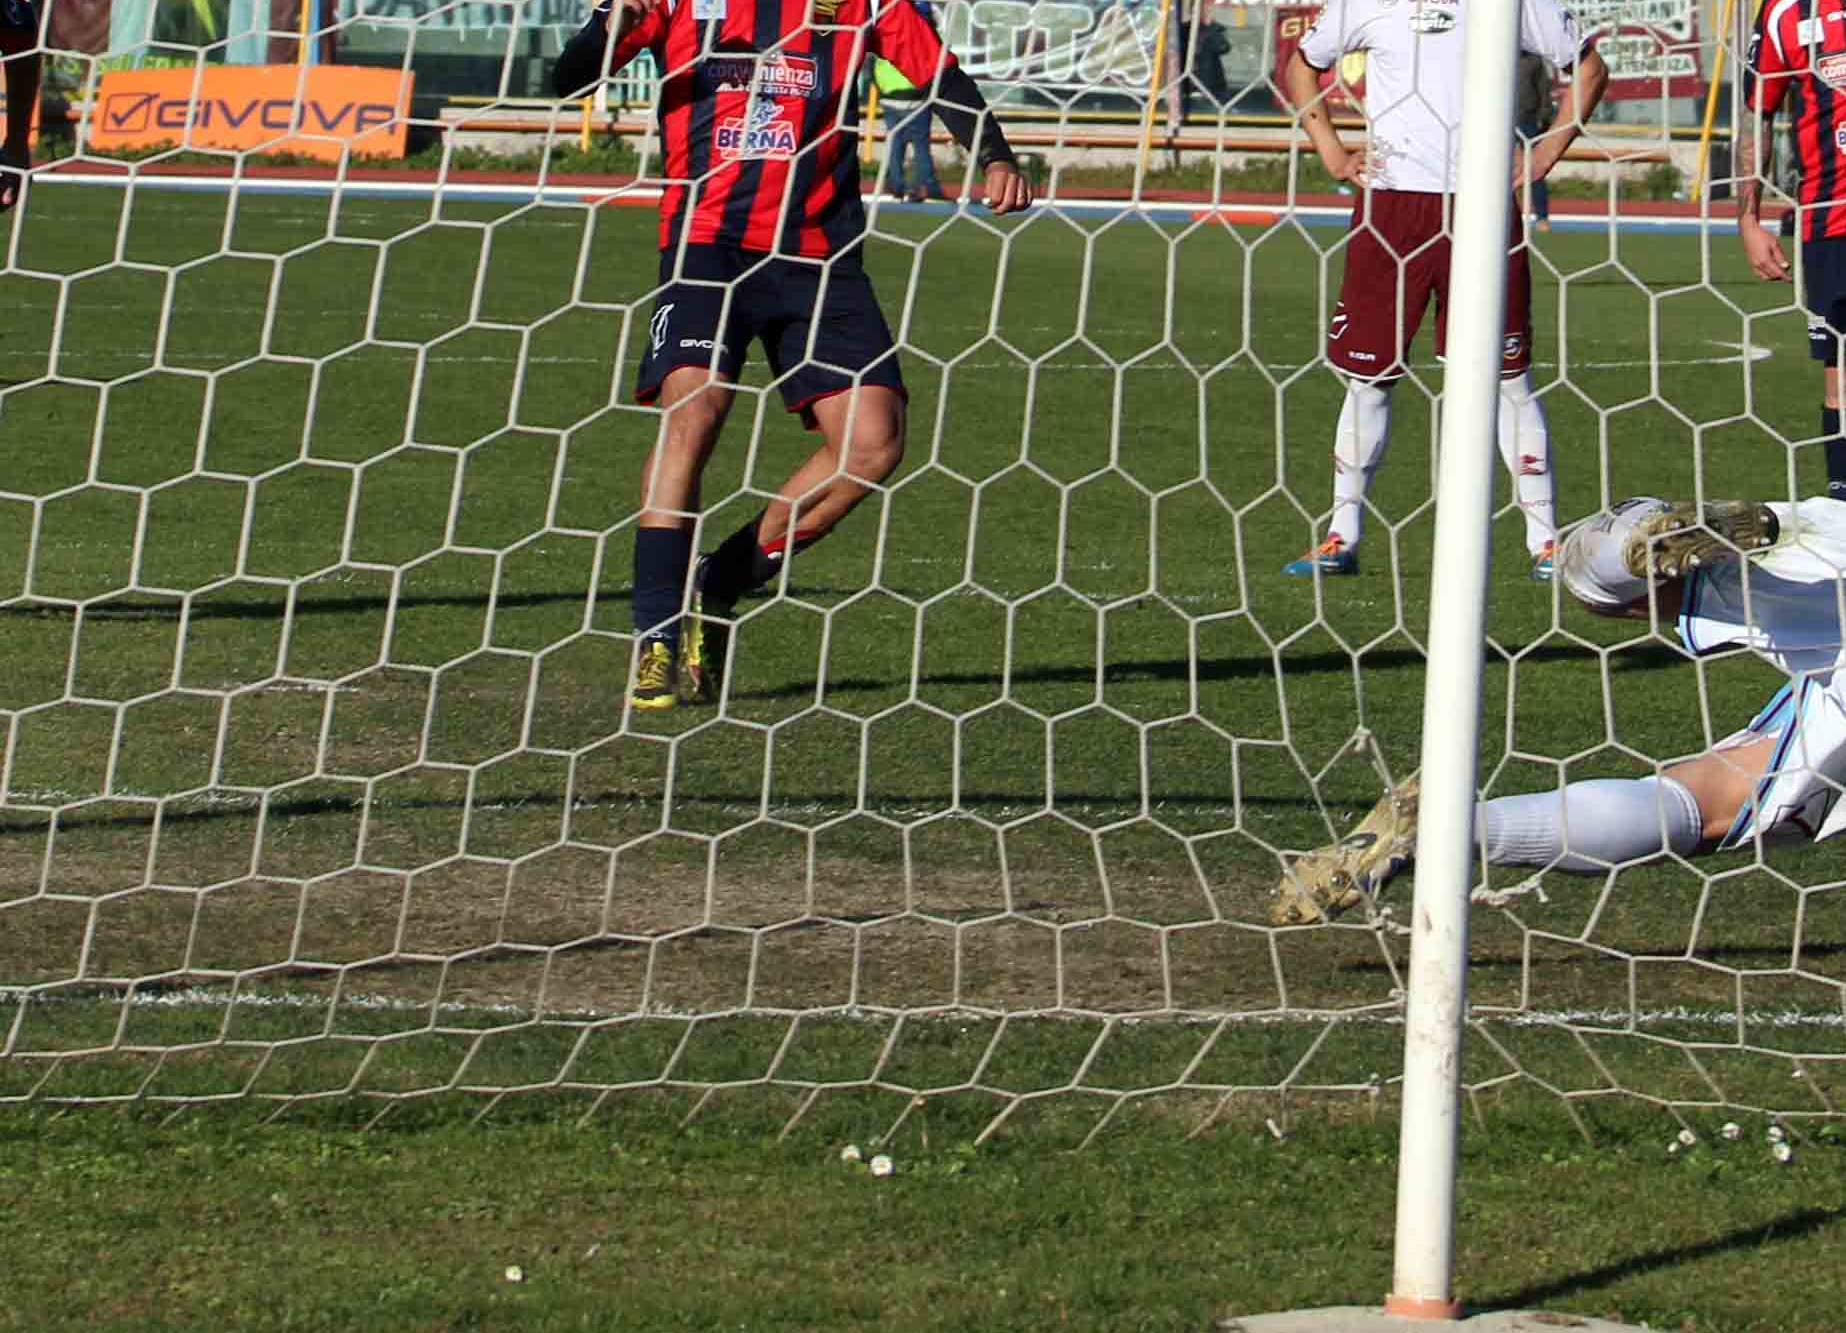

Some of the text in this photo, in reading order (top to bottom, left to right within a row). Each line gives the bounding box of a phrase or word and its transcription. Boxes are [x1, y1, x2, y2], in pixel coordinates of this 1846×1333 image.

[156, 99, 398, 134] GIVOVA
[717, 129, 793, 149] BERNA
[679, 338, 729, 353] GIVOA
